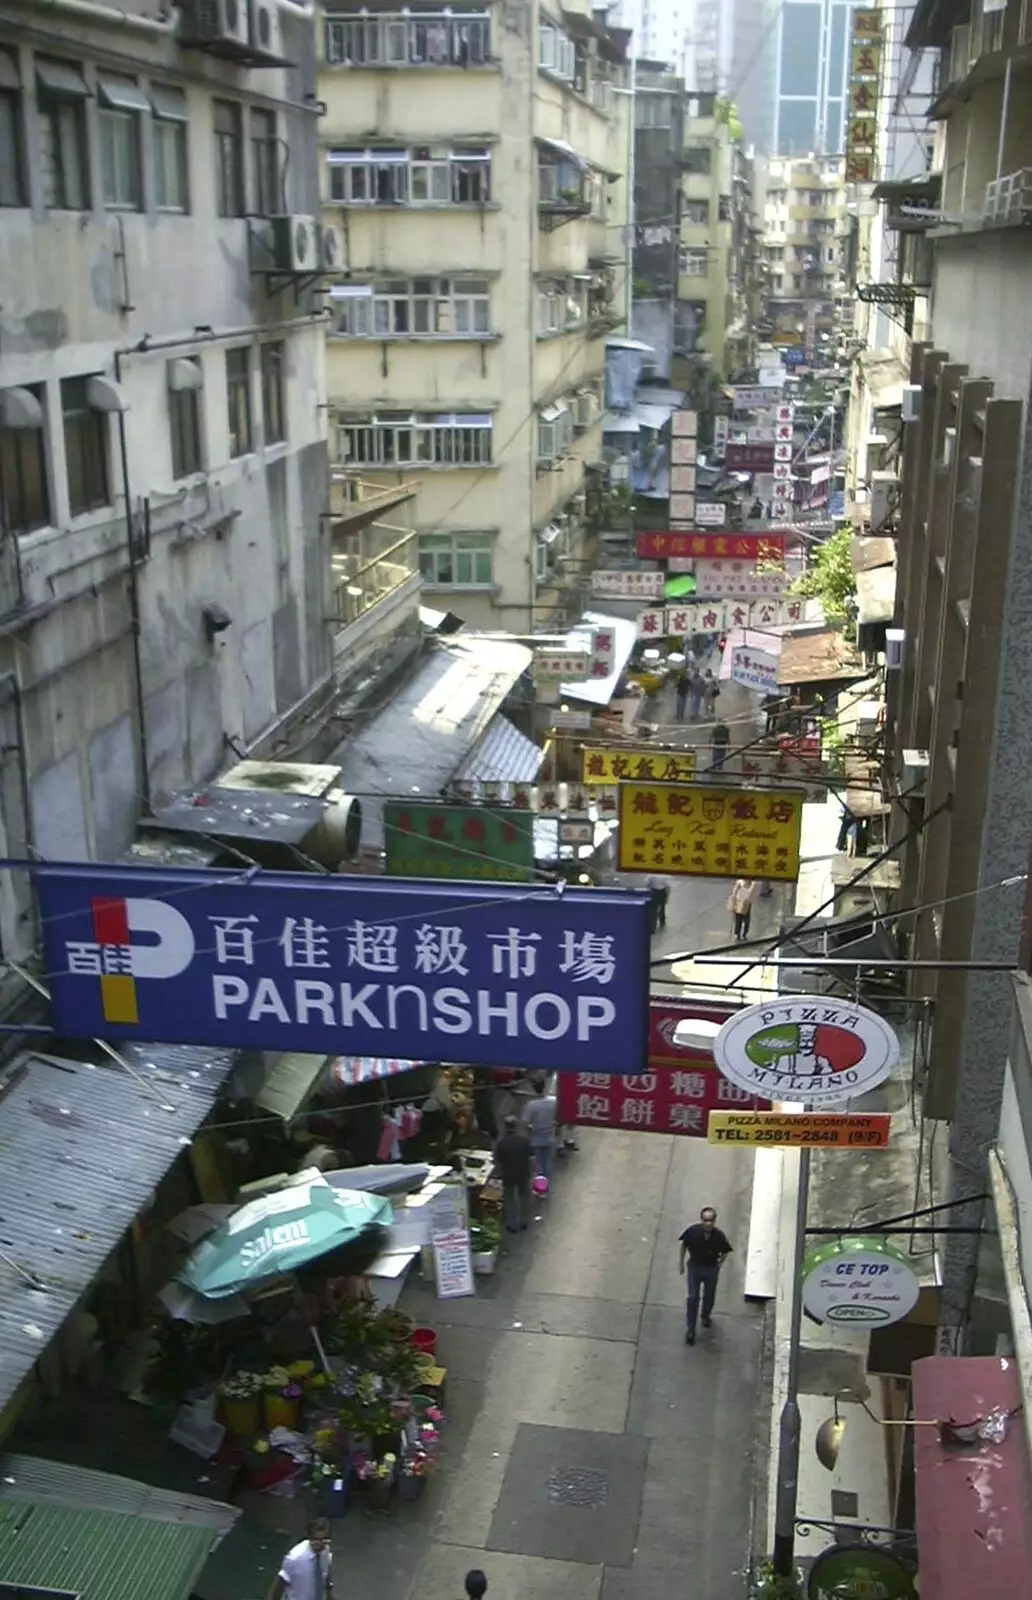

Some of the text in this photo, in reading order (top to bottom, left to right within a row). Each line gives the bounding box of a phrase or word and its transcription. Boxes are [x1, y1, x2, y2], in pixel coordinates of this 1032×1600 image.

[761, 1008, 861, 1029] PIZZA
[748, 1068, 859, 1091] MILANO
[728, 1116, 872, 1128] PIZZA MILANO COMPANY
[716, 1128, 749, 1141] TEL:
[238, 1218, 309, 1268] Salem
[860, 1263, 890, 1276] TOP
